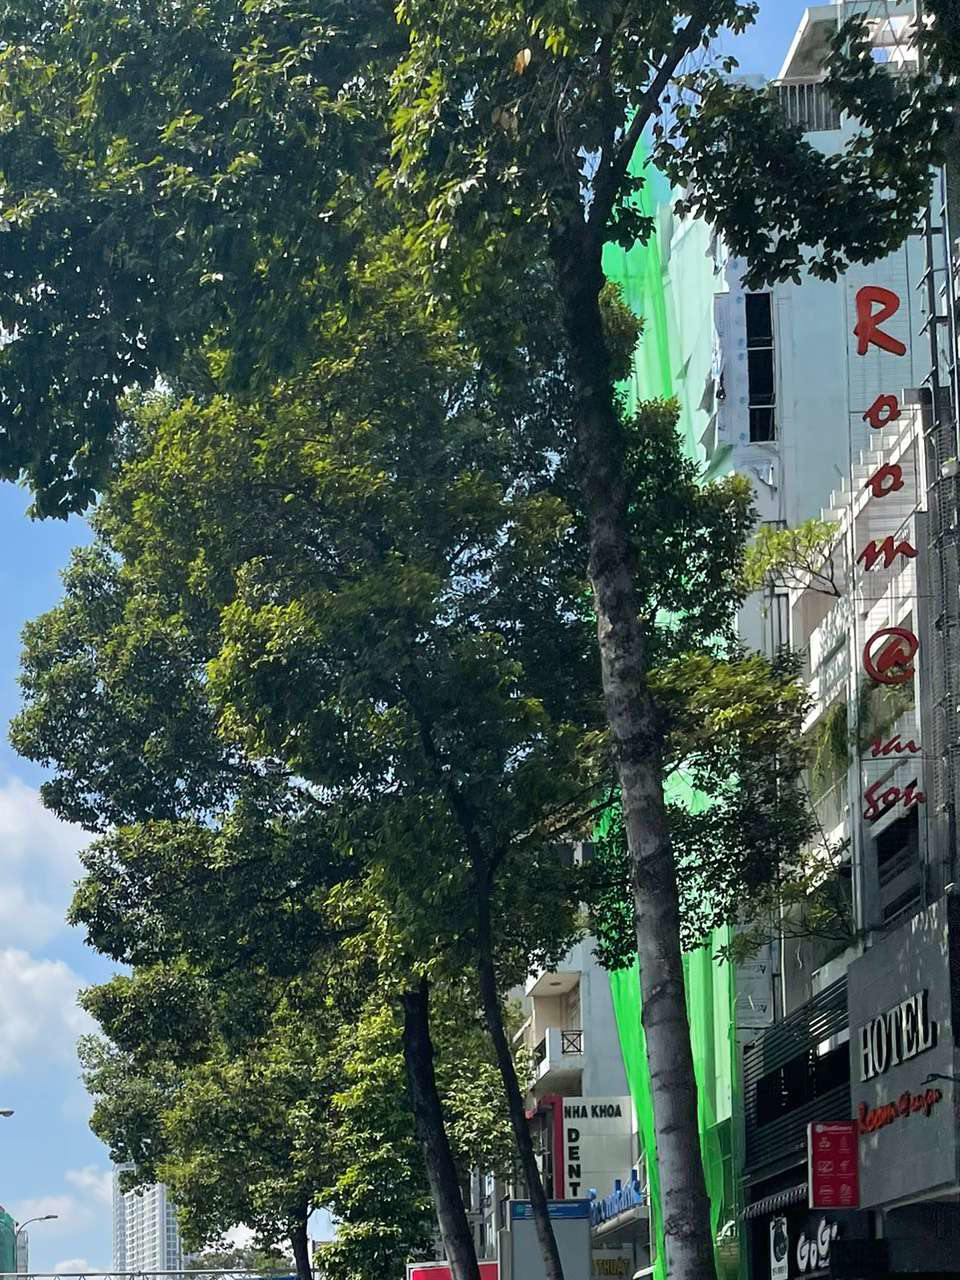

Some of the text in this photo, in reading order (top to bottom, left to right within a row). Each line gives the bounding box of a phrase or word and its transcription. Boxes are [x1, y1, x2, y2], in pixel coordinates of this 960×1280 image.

[858, 991, 933, 1082] HOTEL
[564, 1104, 622, 1119] NHA KHOA
